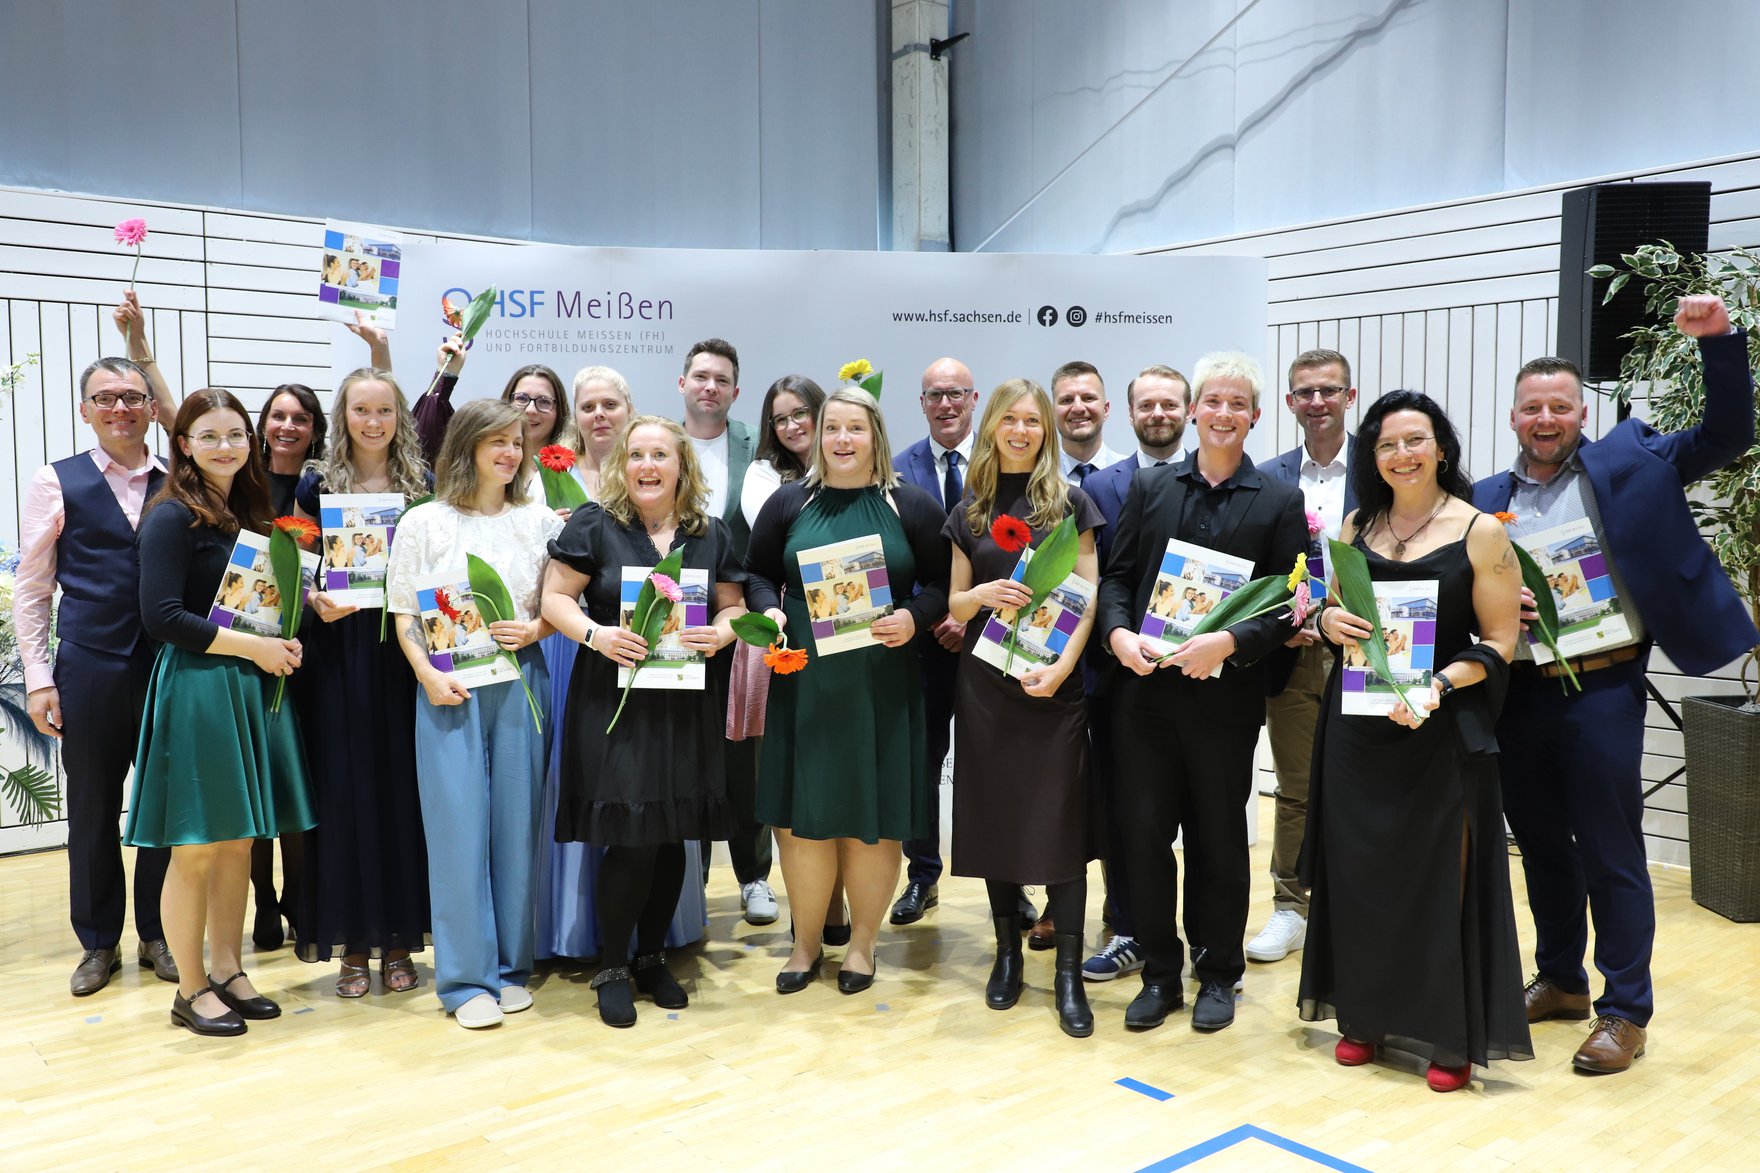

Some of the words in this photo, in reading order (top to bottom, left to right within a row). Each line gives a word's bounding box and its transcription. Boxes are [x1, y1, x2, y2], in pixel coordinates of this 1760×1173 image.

[489, 289, 545, 318] HSF
[557, 291, 673, 320] Meißen
[892, 309, 1022, 324] www.hsf.sachsen.de
[1095, 311, 1173, 325] #hsfmeissen
[485, 329, 569, 339] HOCHSCHULE
[577, 331, 632, 340] MEISSEN
[640, 331, 665, 341] (FH)
[486, 343, 512, 353] UND
[520, 343, 674, 354] FORTBILDUNGSZENTRUM
